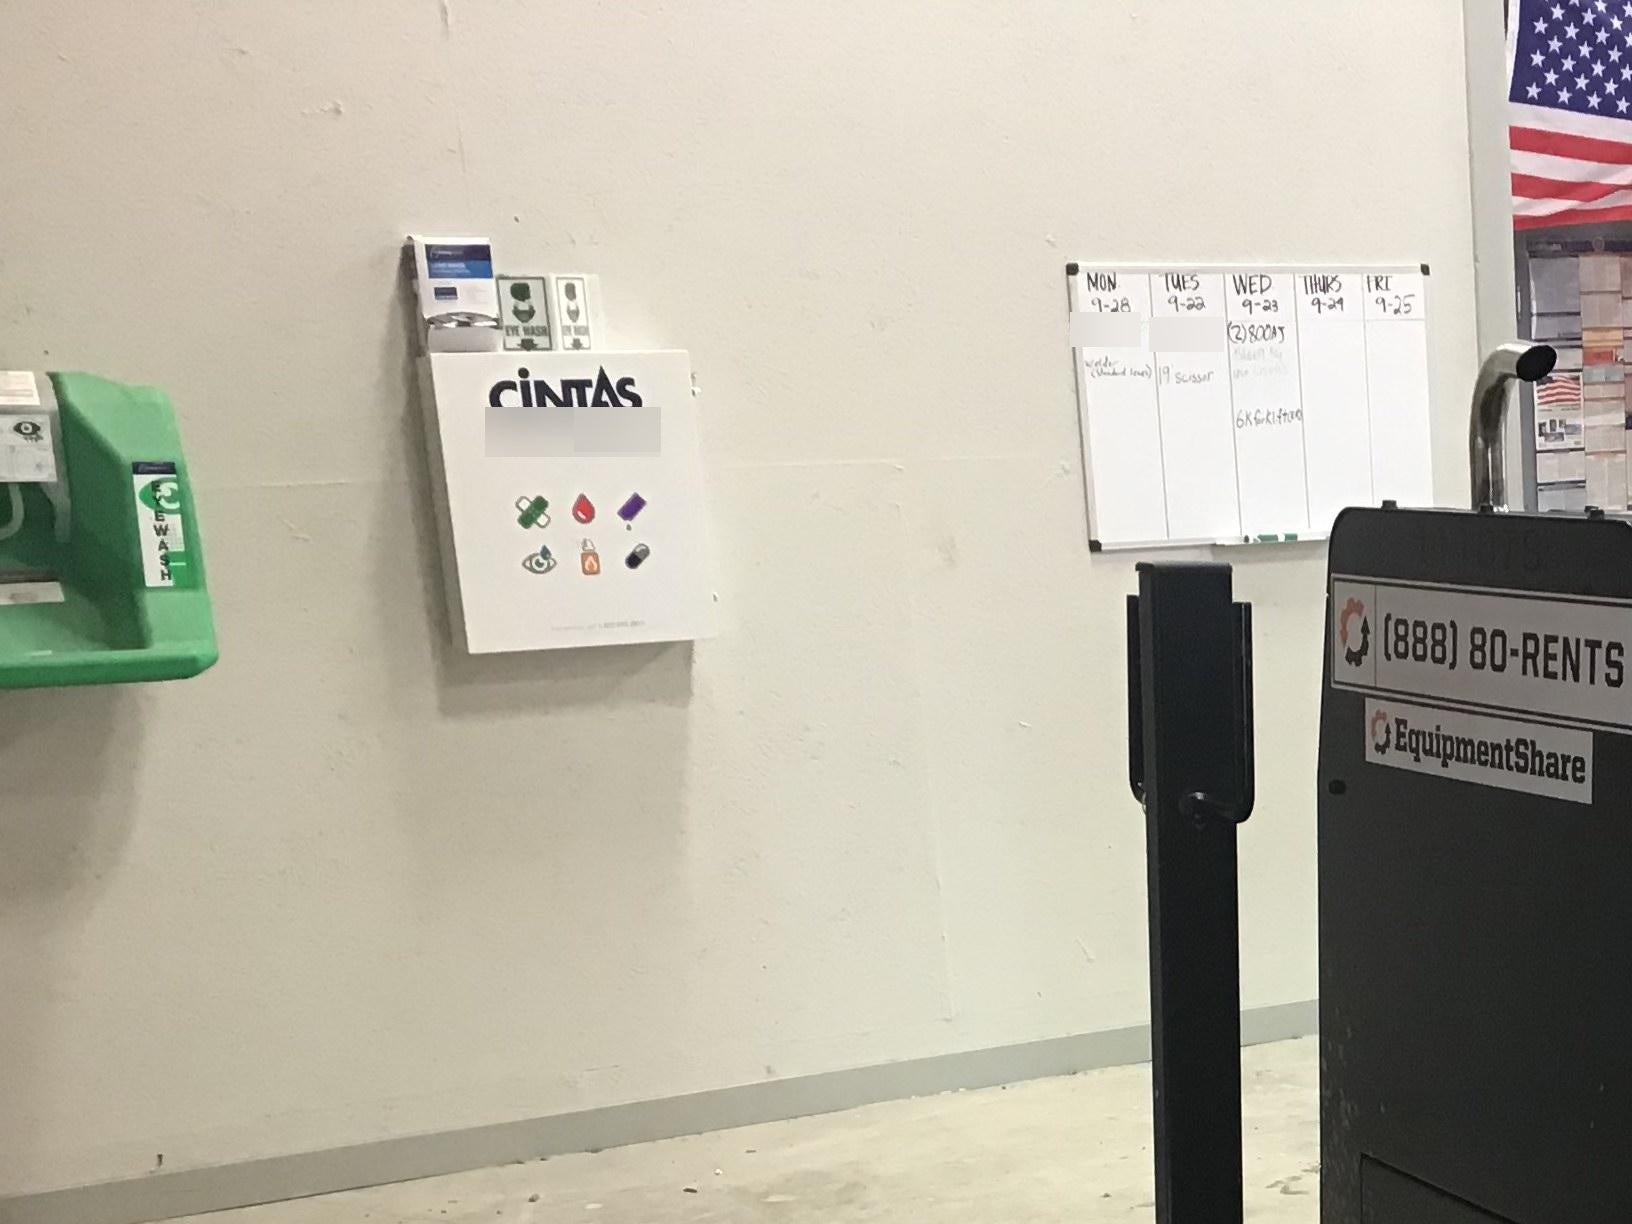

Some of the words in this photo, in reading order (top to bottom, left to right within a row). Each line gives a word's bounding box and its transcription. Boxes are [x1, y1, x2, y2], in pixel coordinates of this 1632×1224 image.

[1086, 272, 1117, 293] MON
[1161, 272, 1200, 293] TUES
[1233, 274, 1273, 296] WED
[1301, 274, 1342, 295] THURS
[1366, 274, 1393, 293] FRI
[1167, 295, 1206, 313] 9-22
[1242, 298, 1279, 314] 9-23
[1311, 297, 1344, 314] 9-24
[1375, 294, 1416, 315] 9-25
[1384, 613, 1457, 670] (888)
[1469, 627, 1624, 688] 80-RENTS
[1394, 717, 1586, 784] EquipmentShare
